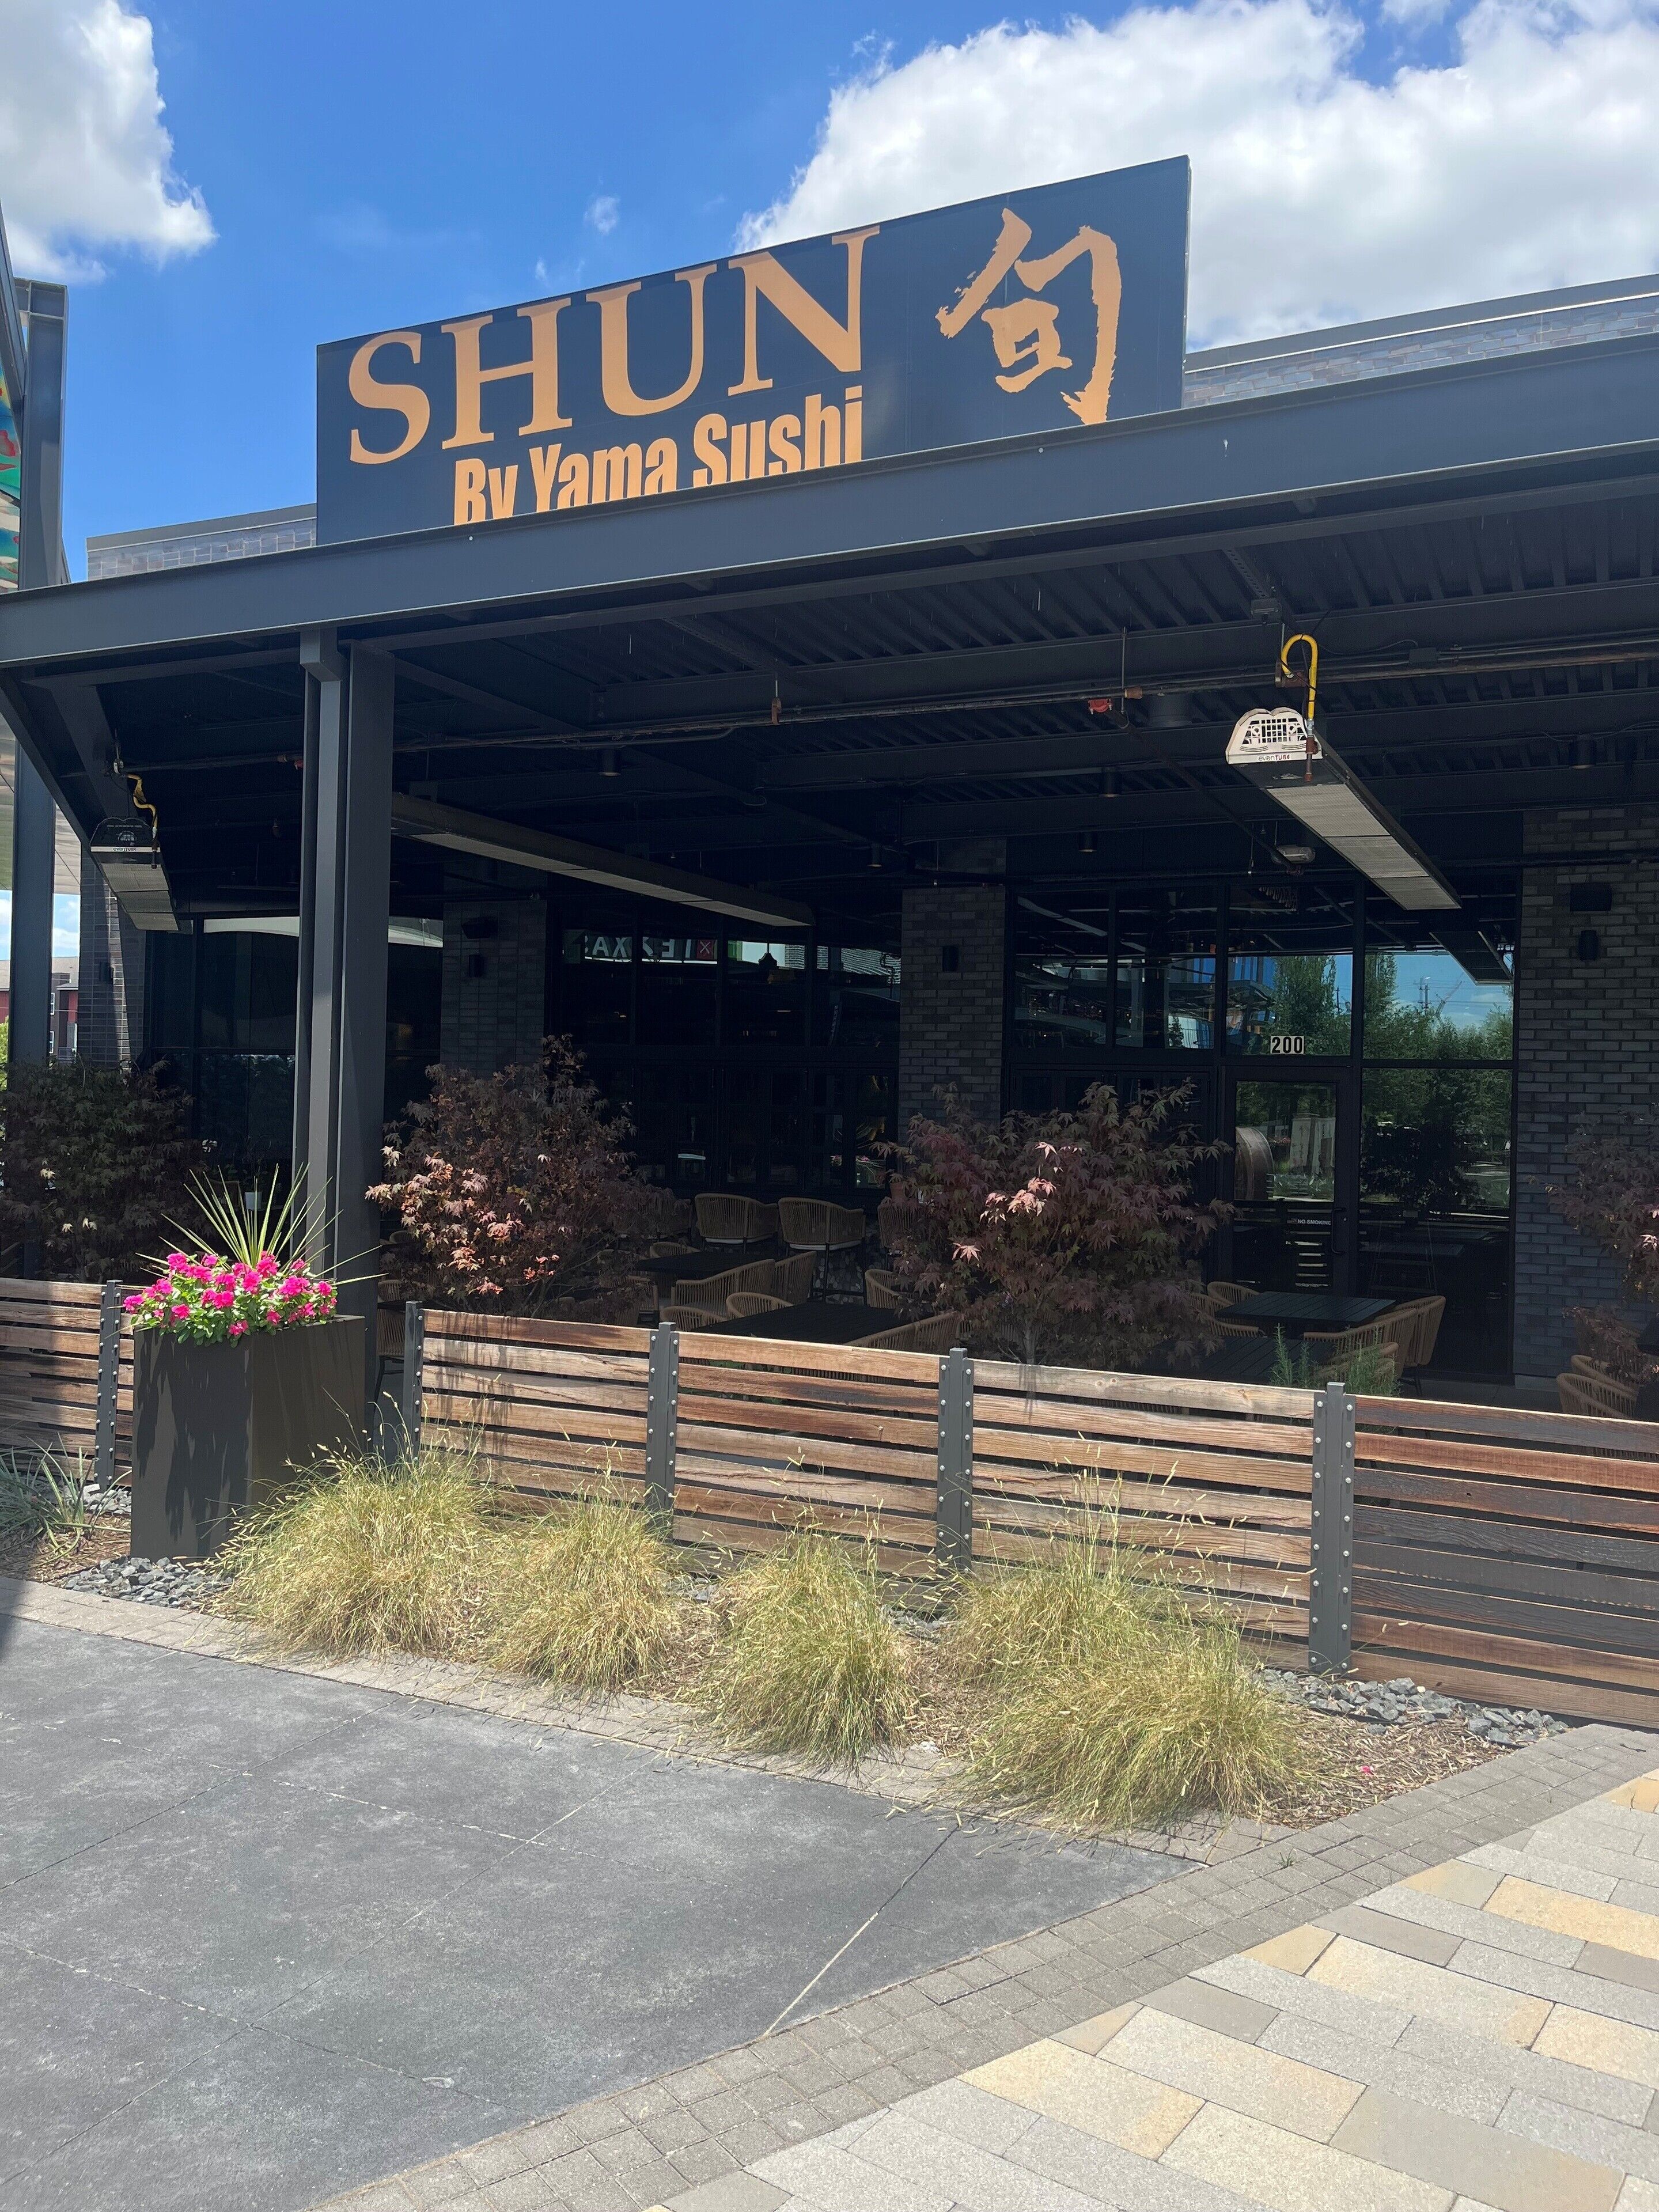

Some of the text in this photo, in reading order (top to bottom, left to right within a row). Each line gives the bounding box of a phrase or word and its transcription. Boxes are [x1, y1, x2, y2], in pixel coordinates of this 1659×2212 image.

[349, 225, 880, 464] SHUN
[935, 207, 1122, 425] 旬
[529, 443, 677, 512] Yama
[693, 385, 862, 487] Sushi
[1271, 1036, 1303, 1054] 200
